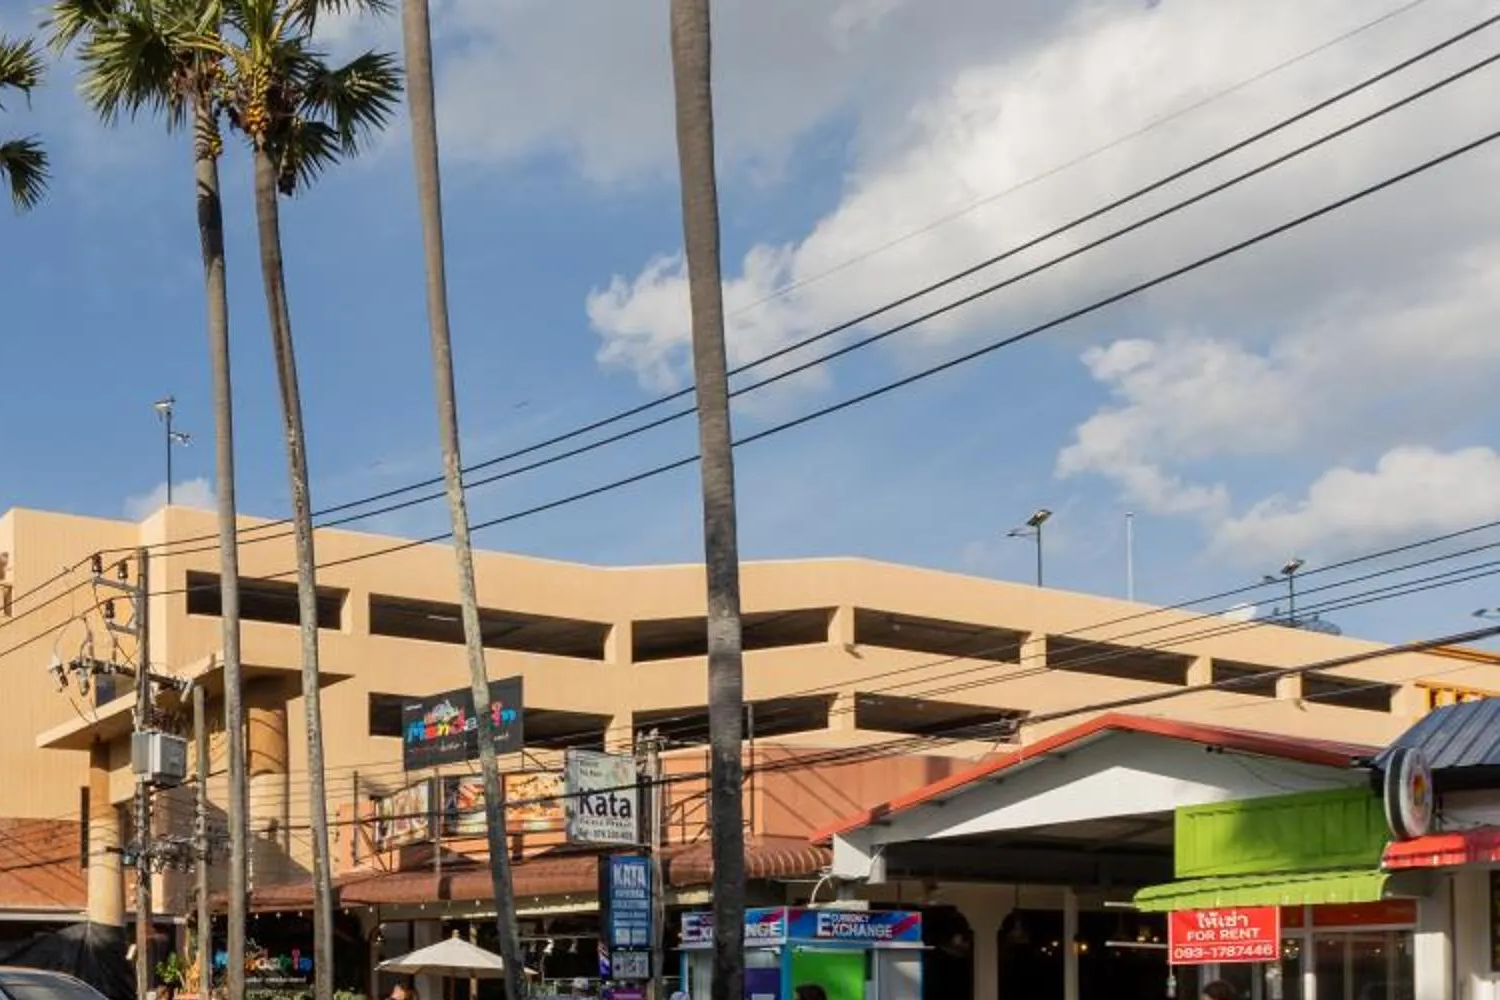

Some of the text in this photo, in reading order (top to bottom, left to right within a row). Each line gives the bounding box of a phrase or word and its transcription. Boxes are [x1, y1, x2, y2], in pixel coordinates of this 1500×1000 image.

[406, 701, 516, 742] Mandain
[580, 786, 632, 818] Kata
[613, 863, 646, 888] KATA
[816, 911, 894, 938] EXCHANGE
[1187, 927, 1260, 942] FOR RENT
